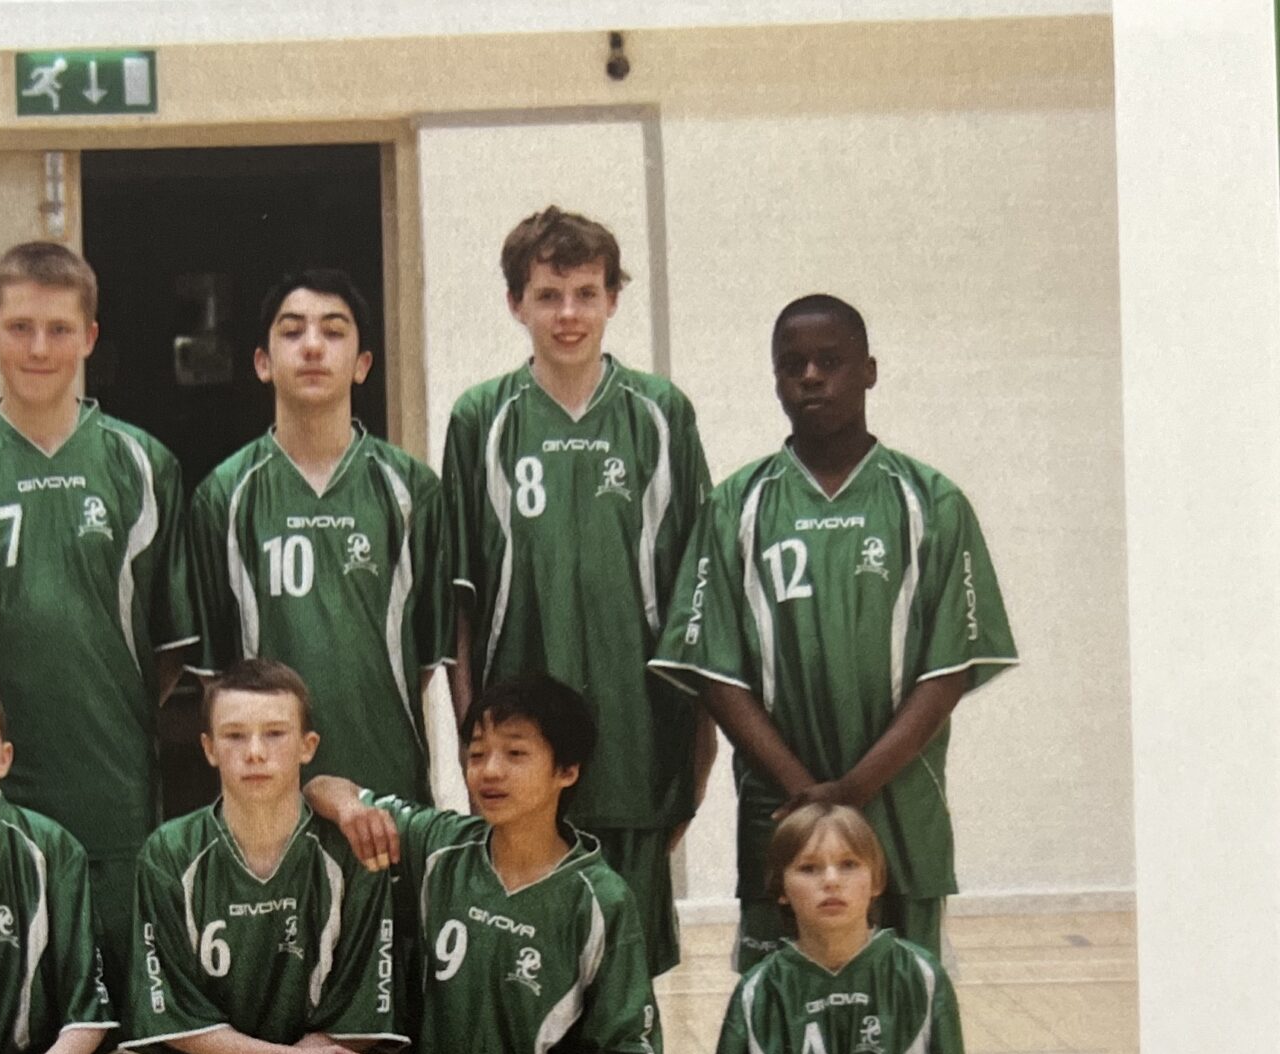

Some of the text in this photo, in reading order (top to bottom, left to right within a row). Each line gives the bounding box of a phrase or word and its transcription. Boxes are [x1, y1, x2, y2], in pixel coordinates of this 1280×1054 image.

[542, 438, 610, 453] GIVOVA
[17, 476, 86, 492] GIVOVA
[514, 456, 547, 518] 8
[286, 514, 355, 529] GIVOVA
[794, 516, 865, 531] GIVOVA
[263, 535, 314, 598] 10
[762, 538, 813, 603] 12
[229, 897, 297, 916] GIVOVA
[468, 906, 536, 938] GIVOVA
[144, 922, 166, 1014] GIVOVA
[200, 919, 231, 977] 6
[376, 918, 393, 1014] GIVOVA
[435, 919, 468, 981] 9
